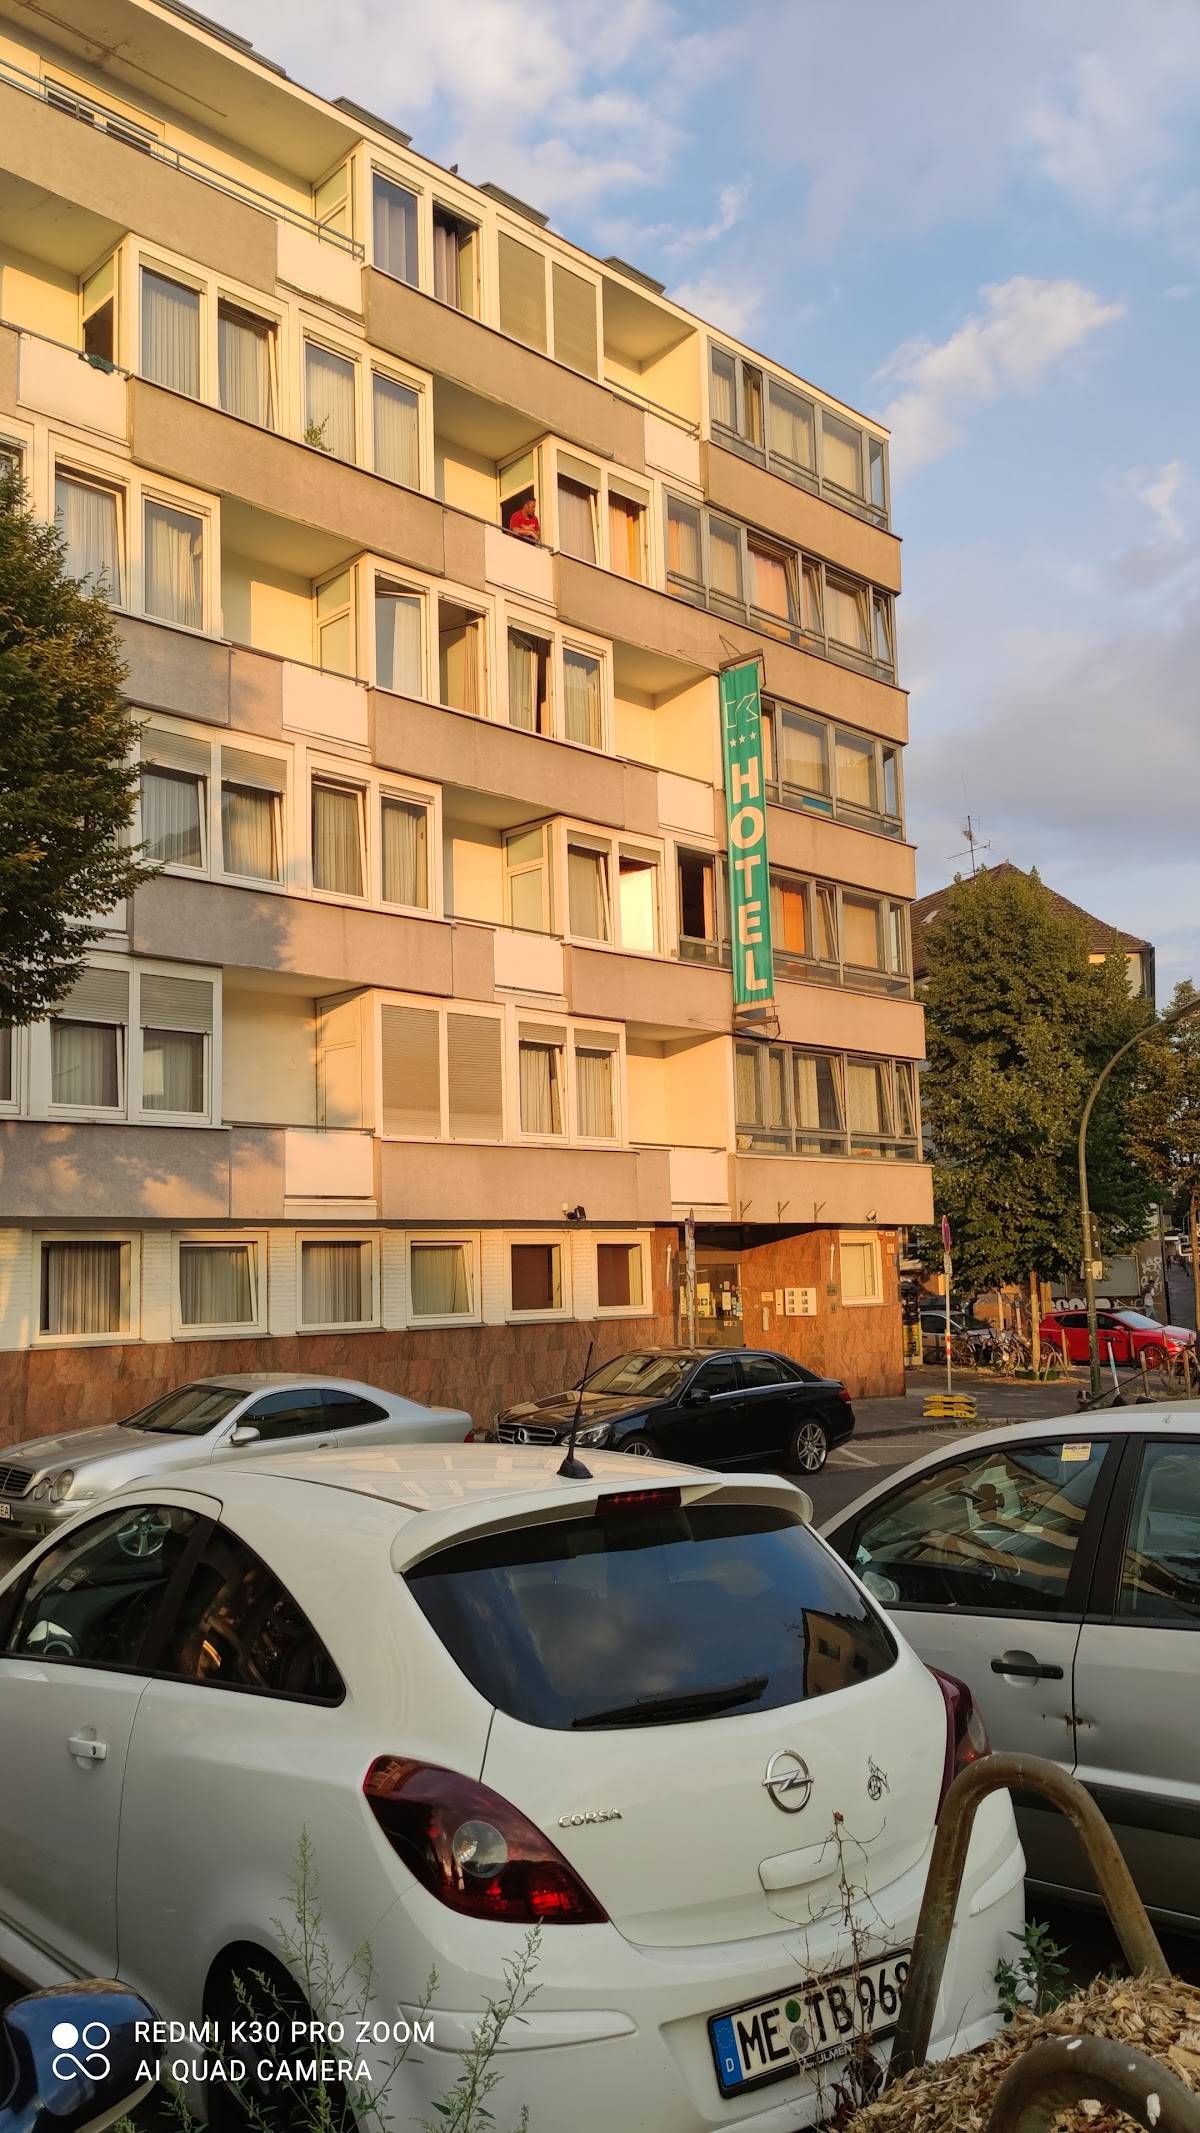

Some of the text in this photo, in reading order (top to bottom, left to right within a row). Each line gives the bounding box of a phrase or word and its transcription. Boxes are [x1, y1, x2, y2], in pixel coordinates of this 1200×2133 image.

[731, 756, 768, 992] HOTEL
[559, 1808, 622, 1828] CORSA
[737, 2007, 790, 2071] ME
